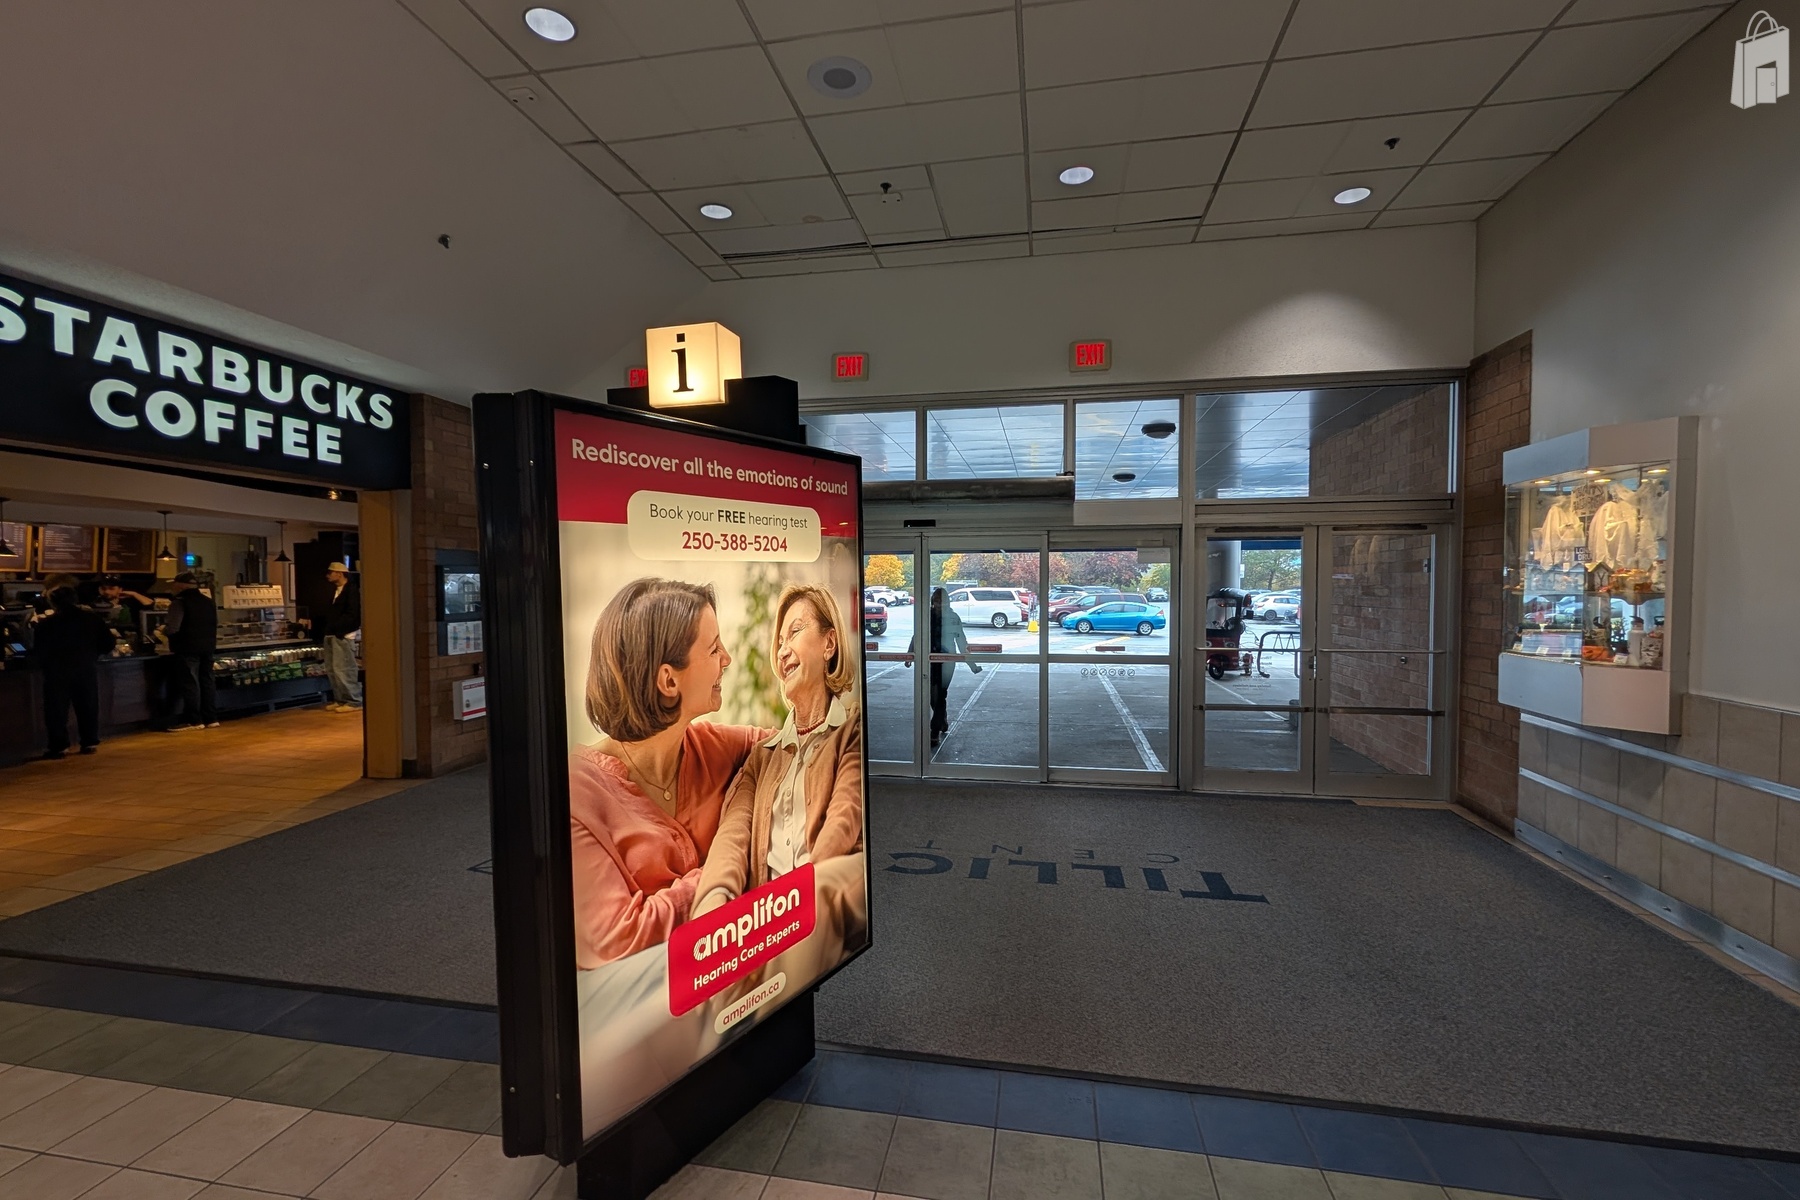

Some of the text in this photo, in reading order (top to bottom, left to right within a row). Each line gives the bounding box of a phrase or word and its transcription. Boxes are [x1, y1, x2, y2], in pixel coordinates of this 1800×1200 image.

[0, 286, 394, 430] STARBUCKS
[630, 368, 648, 388] EX
[670, 333, 694, 393] i
[837, 356, 863, 377] EXIT
[1076, 344, 1105, 365] EXIT
[90, 379, 343, 465] COFFEE
[571, 438, 848, 496] Rediscover all the emotions of sound
[649, 504, 808, 530] Book your FREE hearing test
[682, 531, 788, 553] 250-388-5204
[915, 840, 1180, 864] CENT
[884, 852, 1271, 905] TILLIC
[693, 888, 800, 962] amplifon
[693, 920, 800, 991] Hearing Care Experts
[722, 980, 780, 1026] amplifon.ca
